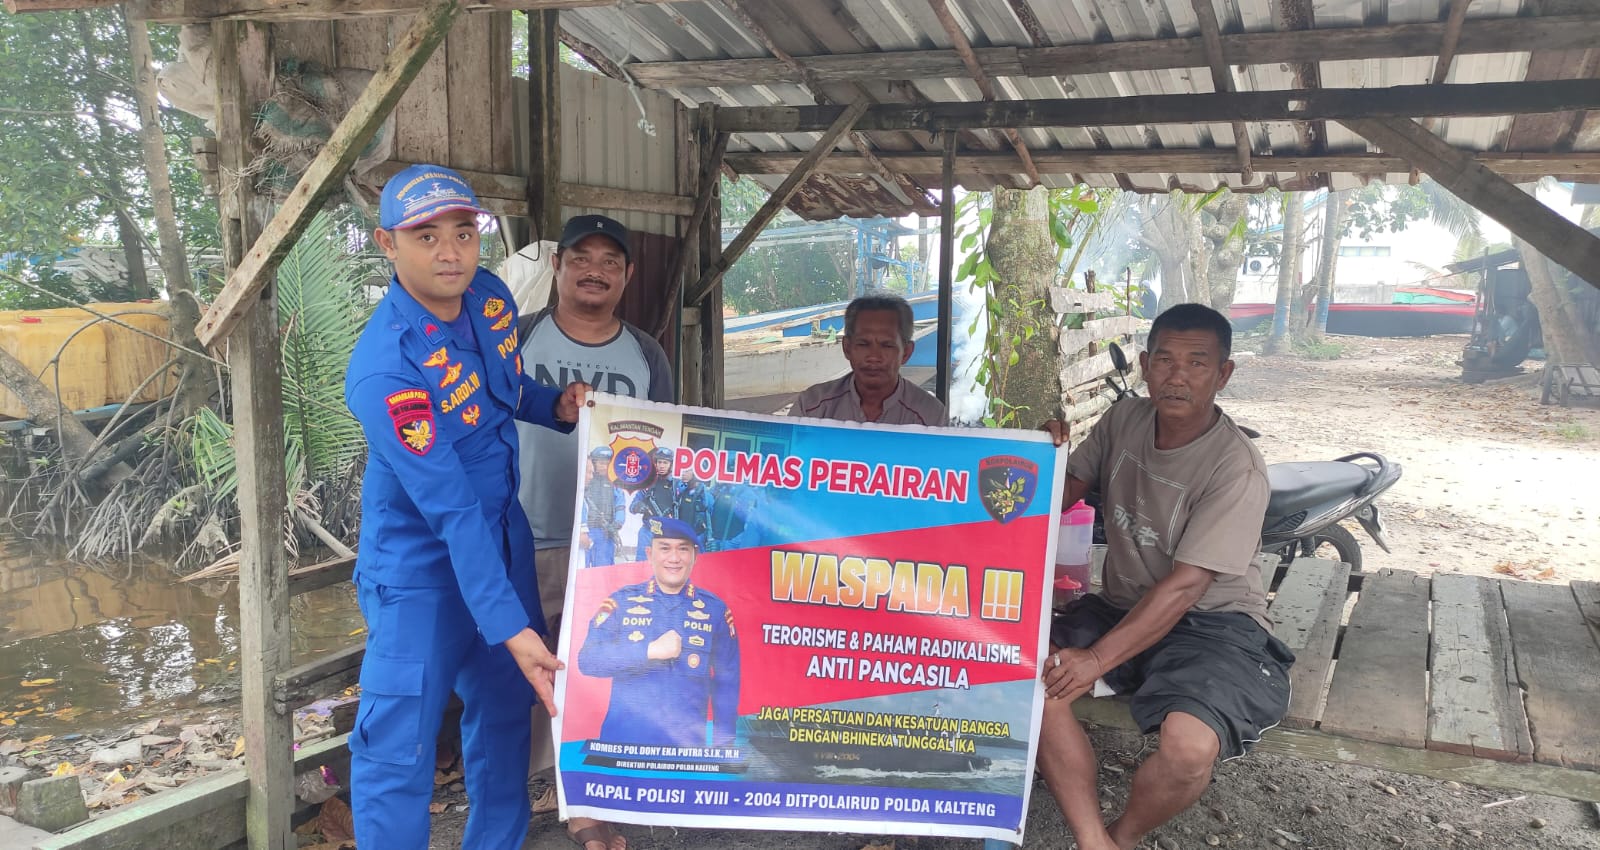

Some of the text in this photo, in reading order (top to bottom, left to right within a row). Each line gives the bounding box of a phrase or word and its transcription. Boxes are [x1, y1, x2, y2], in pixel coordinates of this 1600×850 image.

[610, 422, 640, 431] KALIMANTAN
[673, 447, 968, 503] POLMAS PERAIRAN
[771, 550, 1024, 621] WASPADA !!!
[622, 617, 712, 632] DONY POLRI
[762, 624, 1021, 665] TERORISME & PAHAM RADIKALISME
[806, 655, 970, 690] ANTI PANCASILA
[758, 706, 1010, 736] JAGA PERSATUAN DAN KESATUAN BANGSA
[590, 742, 623, 754] KOMBES
[623, 745, 638, 755] POL
[640, 746, 661, 756] DONY
[662, 747, 677, 756] EKA
[678, 748, 703, 757] PUTRA
[789, 728, 975, 752] DENGAN BHINEKA TUNGGAL IKA
[616, 760, 720, 772] DIREKTUR POLAIRUD POLDA KALTENG
[585, 782, 632, 801] KAPAL
[637, 788, 685, 804] POLISI
[694, 790, 729, 805] XVIII
[744, 792, 781, 807] 2004
[785, 793, 880, 811] DITPOLAIRUD
[884, 797, 930, 813] POLDA
[934, 800, 996, 817] KALTENG
